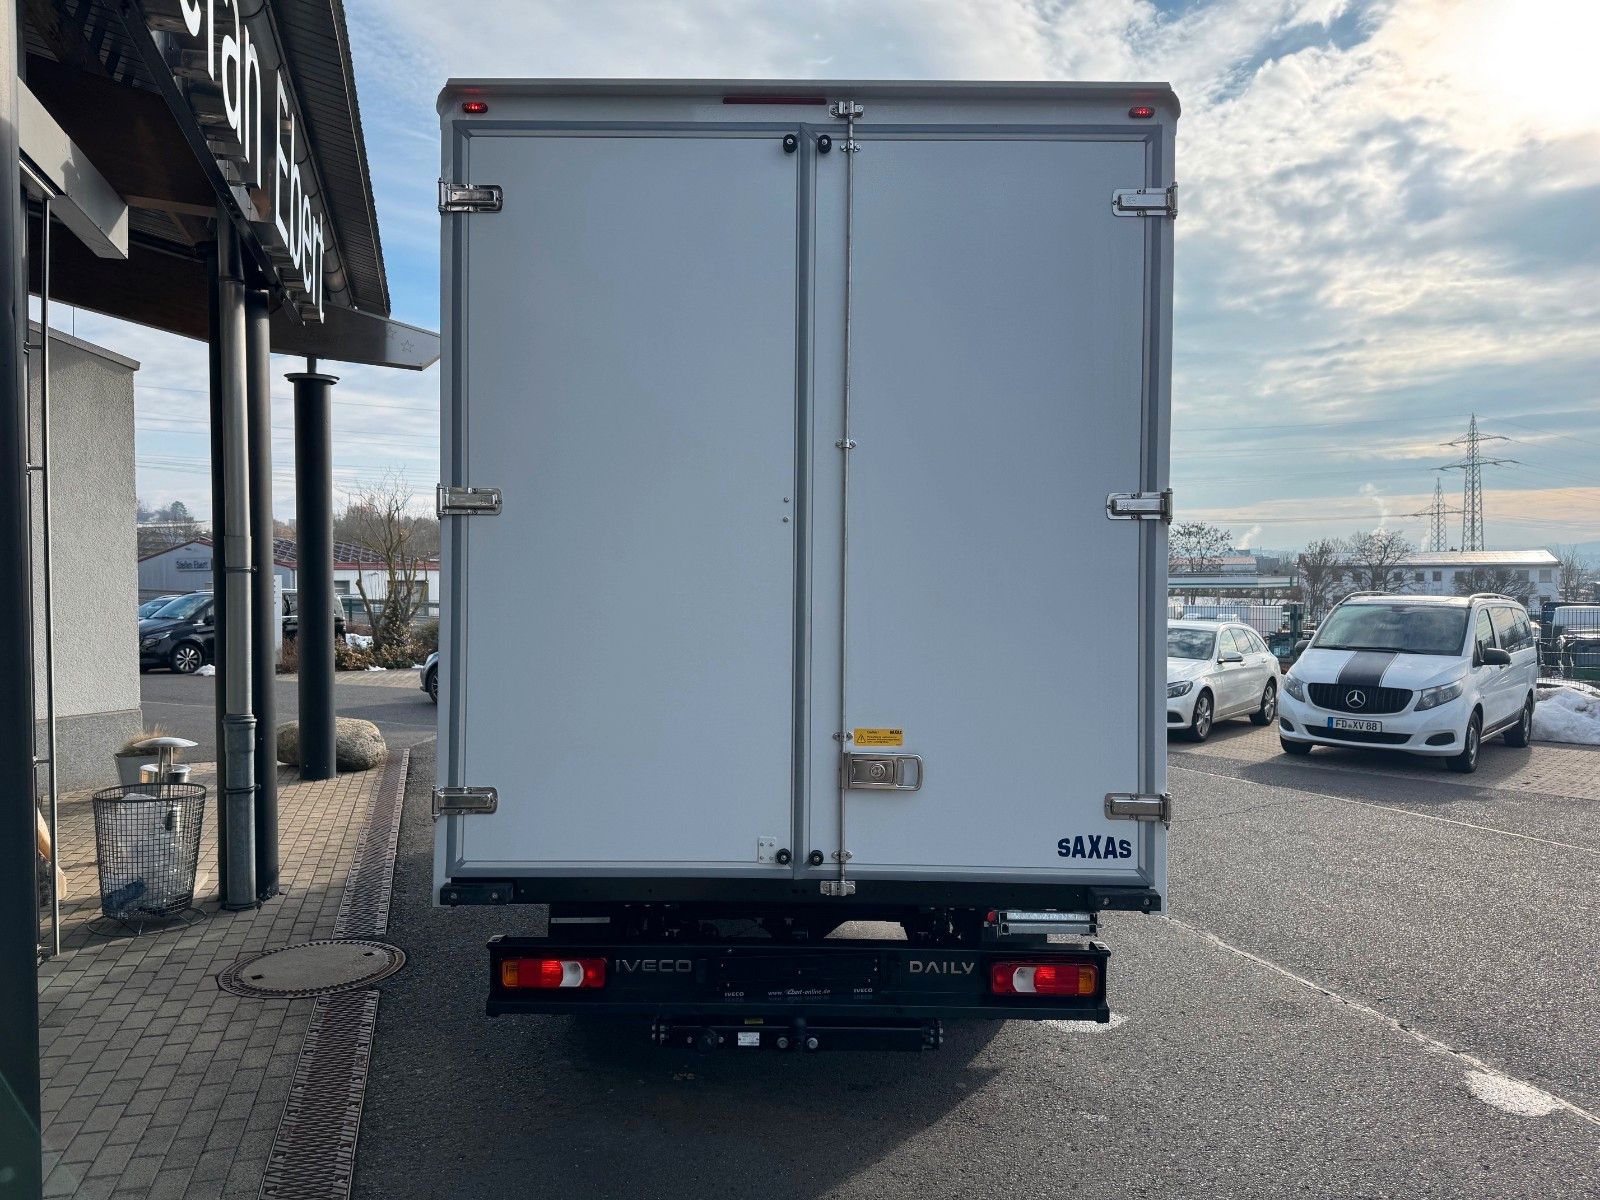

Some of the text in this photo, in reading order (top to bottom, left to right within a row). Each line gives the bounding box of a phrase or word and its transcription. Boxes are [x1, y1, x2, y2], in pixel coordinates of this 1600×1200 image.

[275, 69, 325, 324] Ebert
[1335, 719, 1378, 731] FD XV 88
[1057, 834, 1132, 859] SAXAS
[615, 959, 692, 973] IVECO
[909, 960, 975, 975] DAILY
